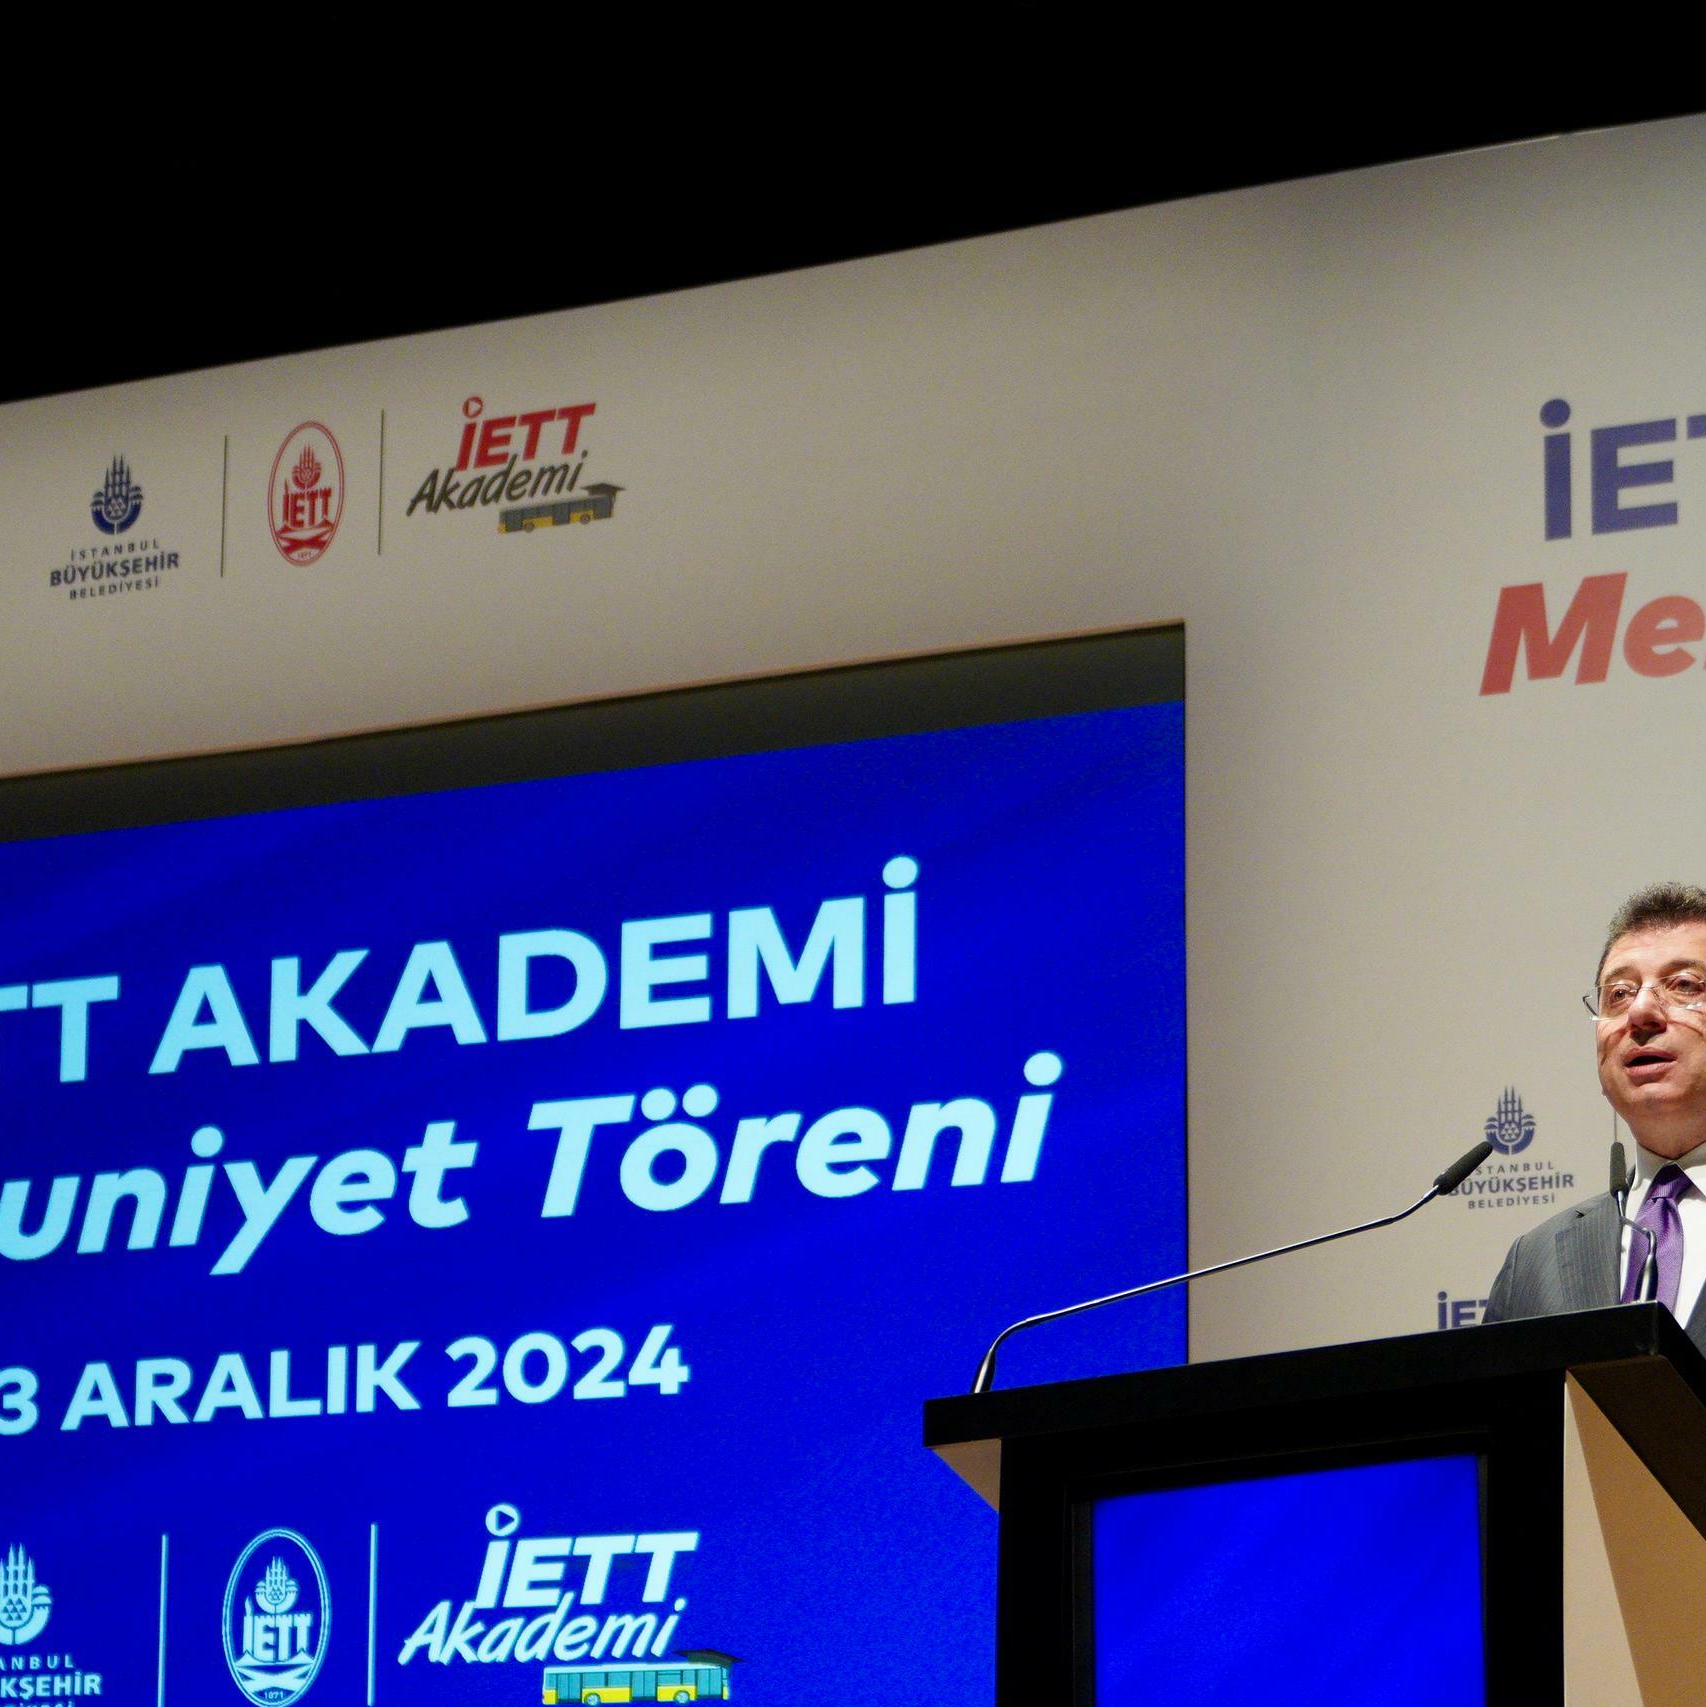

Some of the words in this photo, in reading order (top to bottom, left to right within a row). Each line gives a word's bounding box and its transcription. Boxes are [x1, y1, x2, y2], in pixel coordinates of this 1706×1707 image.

[454, 396, 597, 472] İETT
[405, 450, 588, 516] Akademi
[70, 576, 158, 600] BELEDİYESİ
[149, 856, 918, 1074] AKADEMİ
[528, 1052, 1063, 1217] Töreni
[1475, 1160, 1555, 1176] STANBUL
[1468, 1193, 1555, 1210] BELEDİYESİ
[1437, 1291, 1489, 1331] İE
[61, 1341, 420, 1430] ARALIK
[445, 1325, 690, 1407] 2024
[472, 1503, 699, 1609] İETT
[397, 1592, 685, 1667] Akademi
